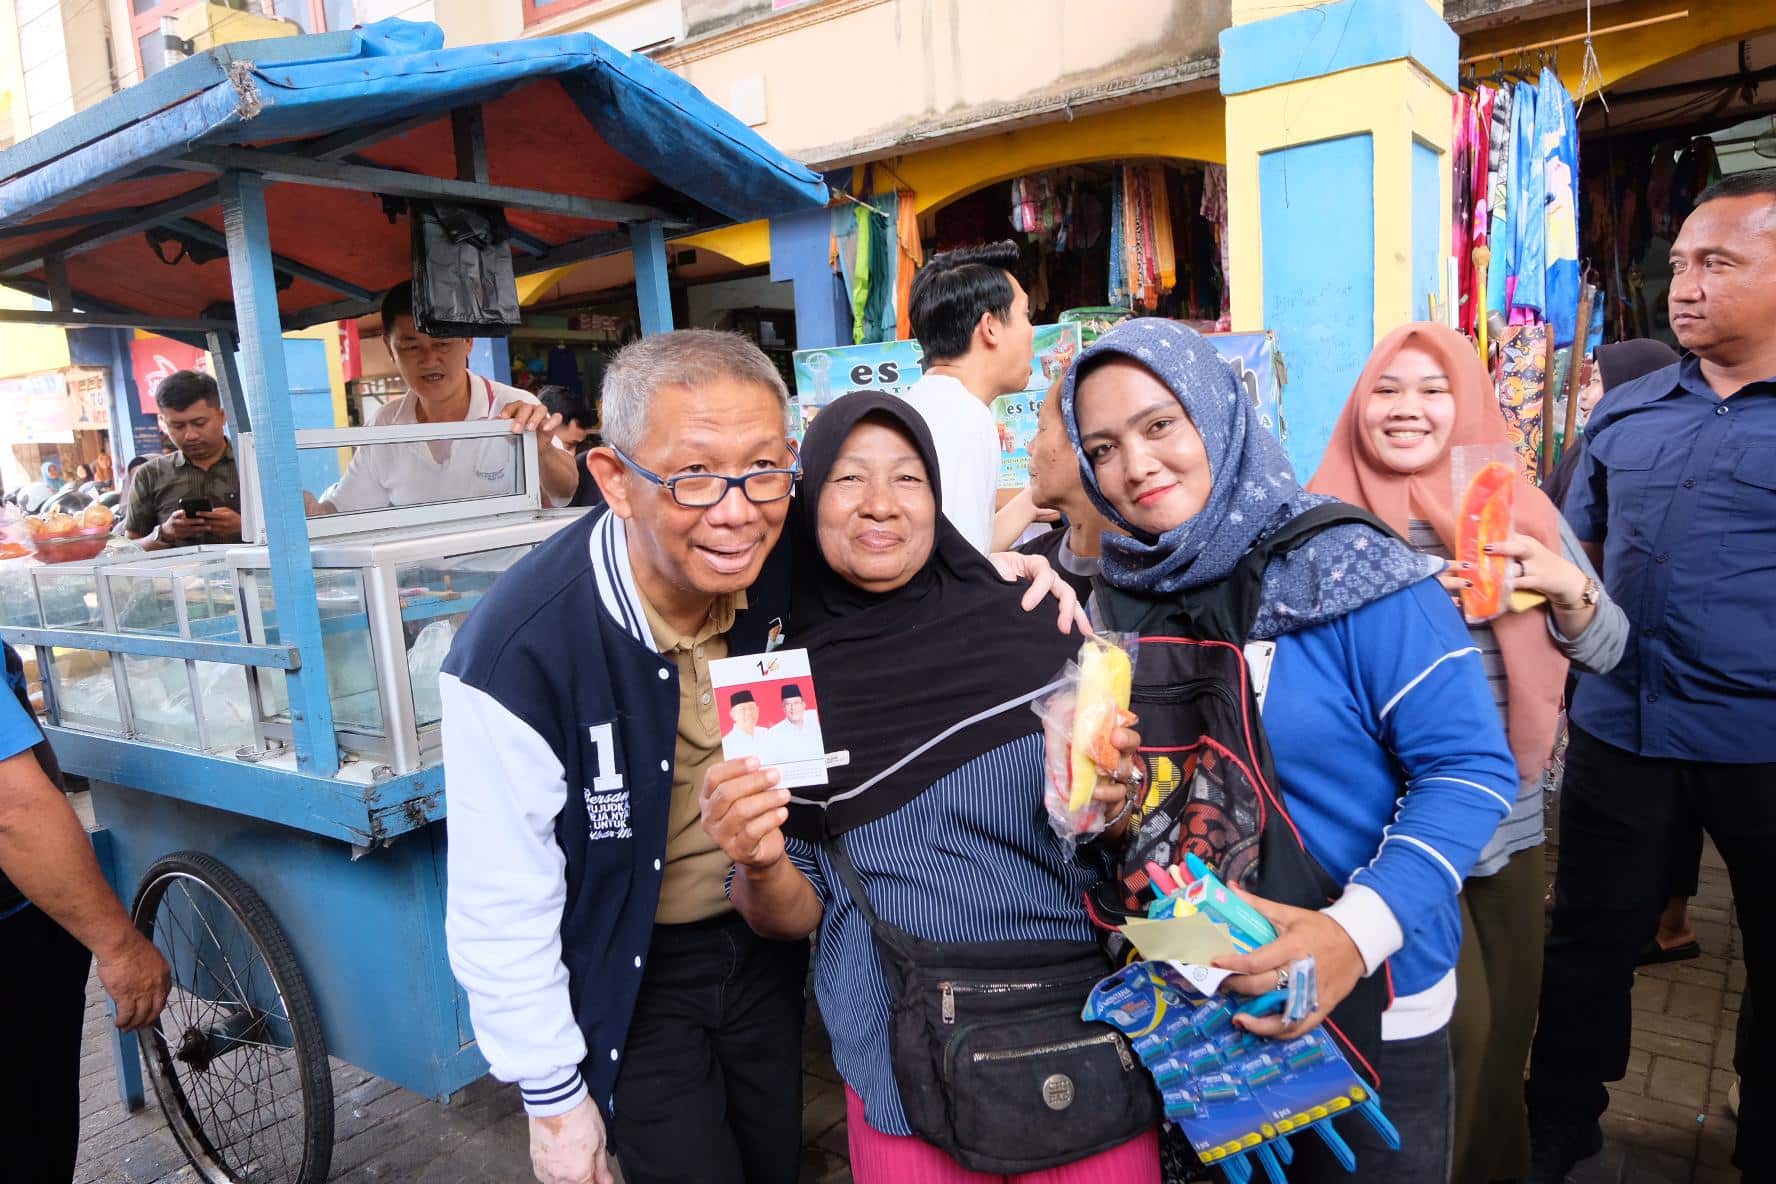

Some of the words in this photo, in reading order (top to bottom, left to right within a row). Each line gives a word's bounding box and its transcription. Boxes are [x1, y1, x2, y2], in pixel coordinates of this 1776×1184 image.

[850, 362, 899, 385] es
[1006, 402, 1023, 415] es
[589, 722, 624, 792] 1
[593, 819, 627, 830] UNTUK
